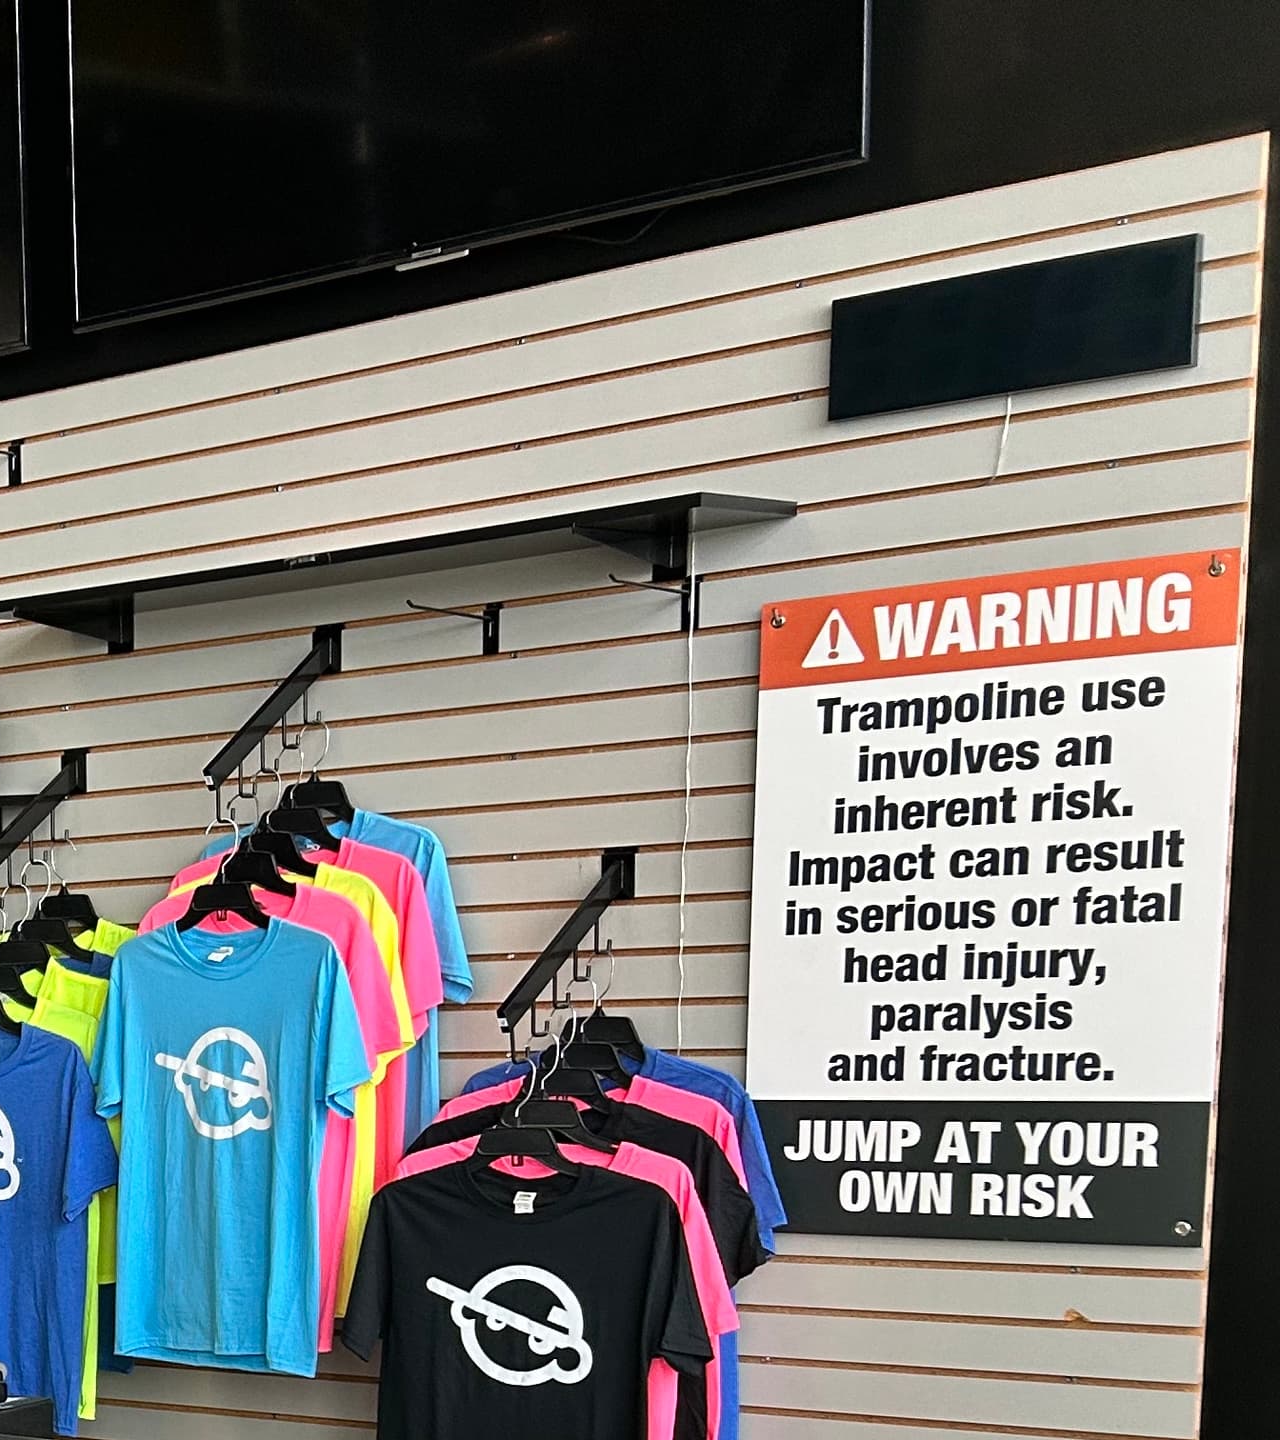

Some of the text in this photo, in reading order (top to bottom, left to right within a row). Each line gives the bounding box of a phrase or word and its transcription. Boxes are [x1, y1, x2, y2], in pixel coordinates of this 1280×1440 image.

[873, 572, 1193, 662] WARNING
[817, 673, 1166, 735] Trampoline use
[858, 733, 1114, 782] involves an
[833, 780, 1134, 835] inherent risk.
[788, 829, 1185, 891] Impact can result
[785, 884, 1182, 935] in serious or fatal
[843, 945, 1107, 987] head injury,
[870, 993, 1074, 1040] paralysis
[828, 1045, 1115, 1081] and fracture.
[782, 1118, 1159, 1168] JUMP AT YOUR
[839, 1170, 1093, 1219] OWN RISK
